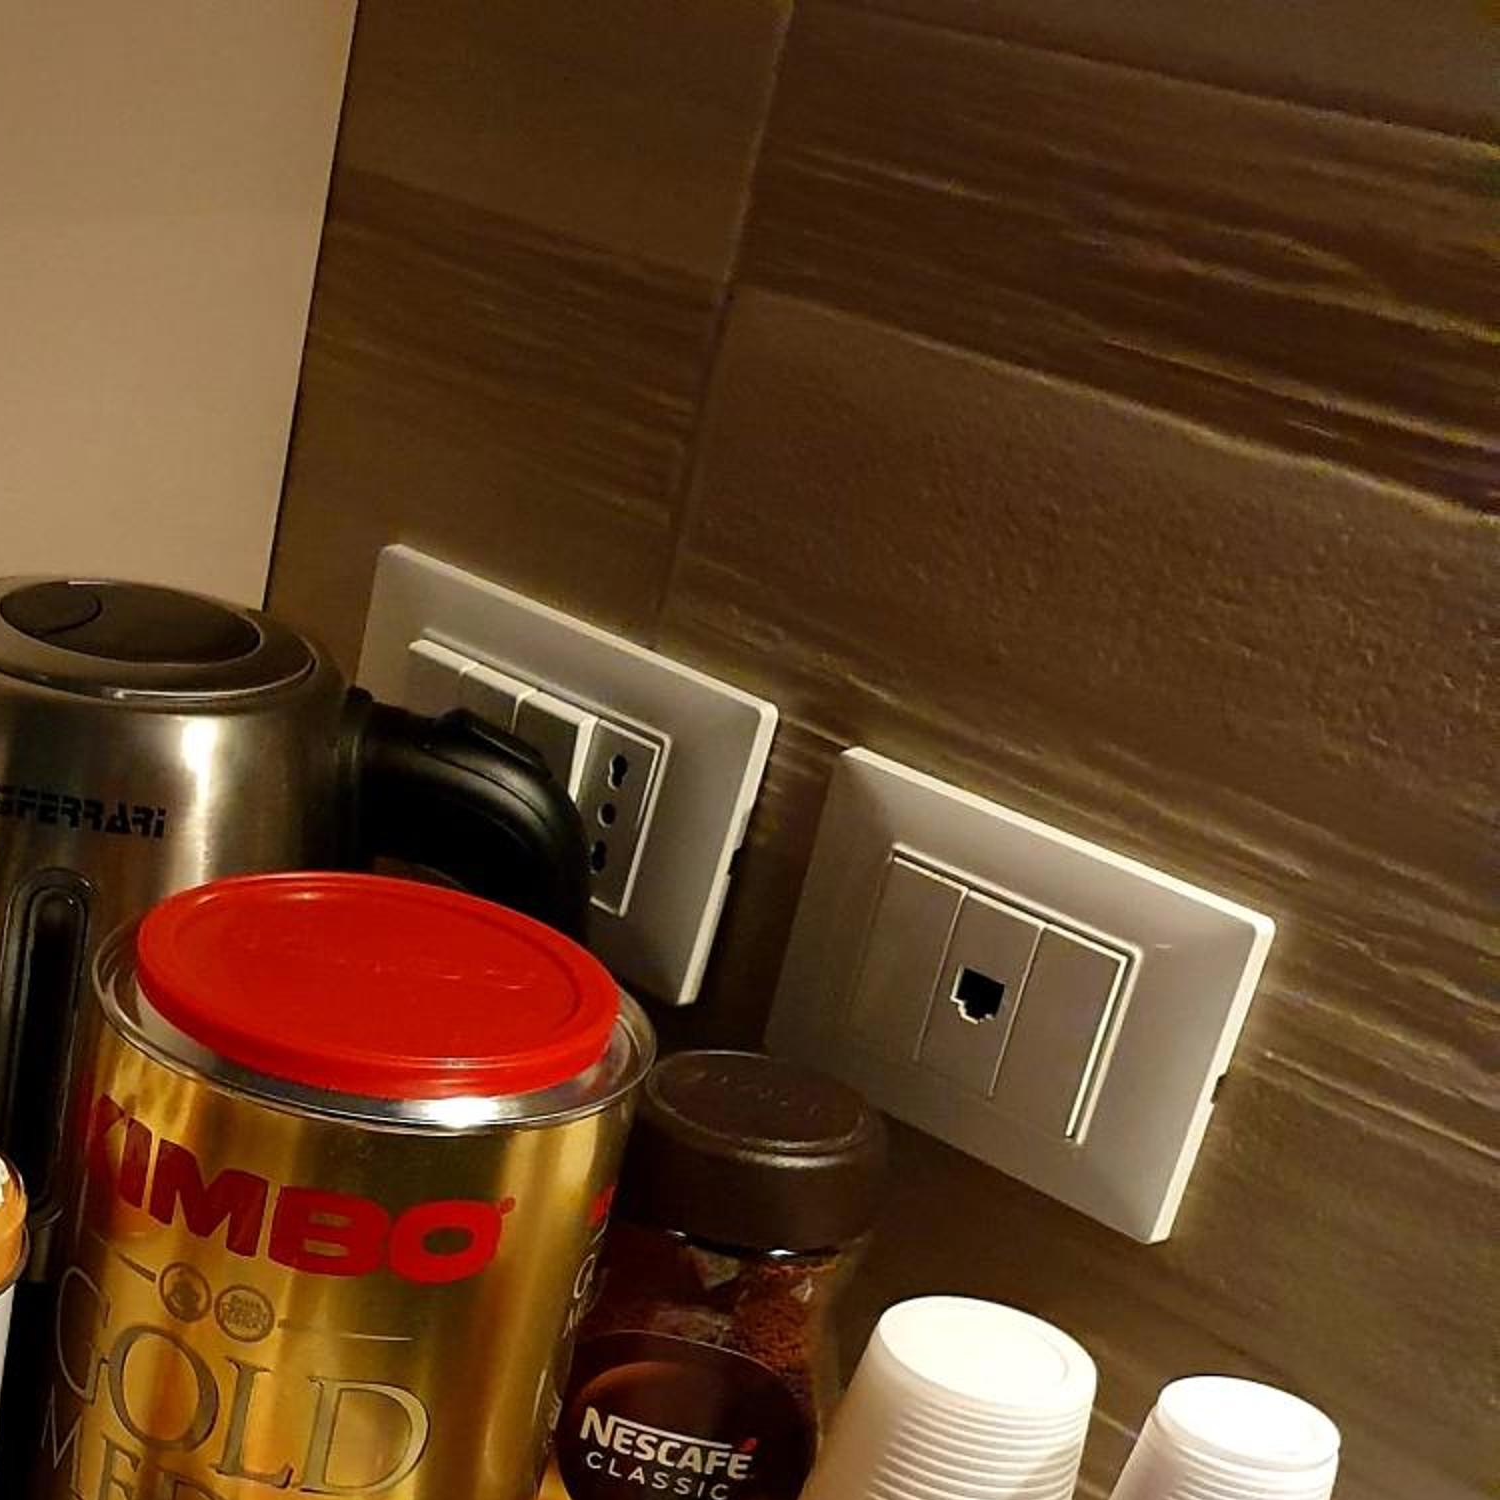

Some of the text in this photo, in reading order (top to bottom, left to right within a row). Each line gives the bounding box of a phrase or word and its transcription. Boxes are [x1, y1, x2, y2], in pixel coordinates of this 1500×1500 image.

[88, 1092, 503, 1284] KIMBO
[56, 1265, 431, 1496] GOLD
[586, 1452, 729, 1500] CLASSIC
